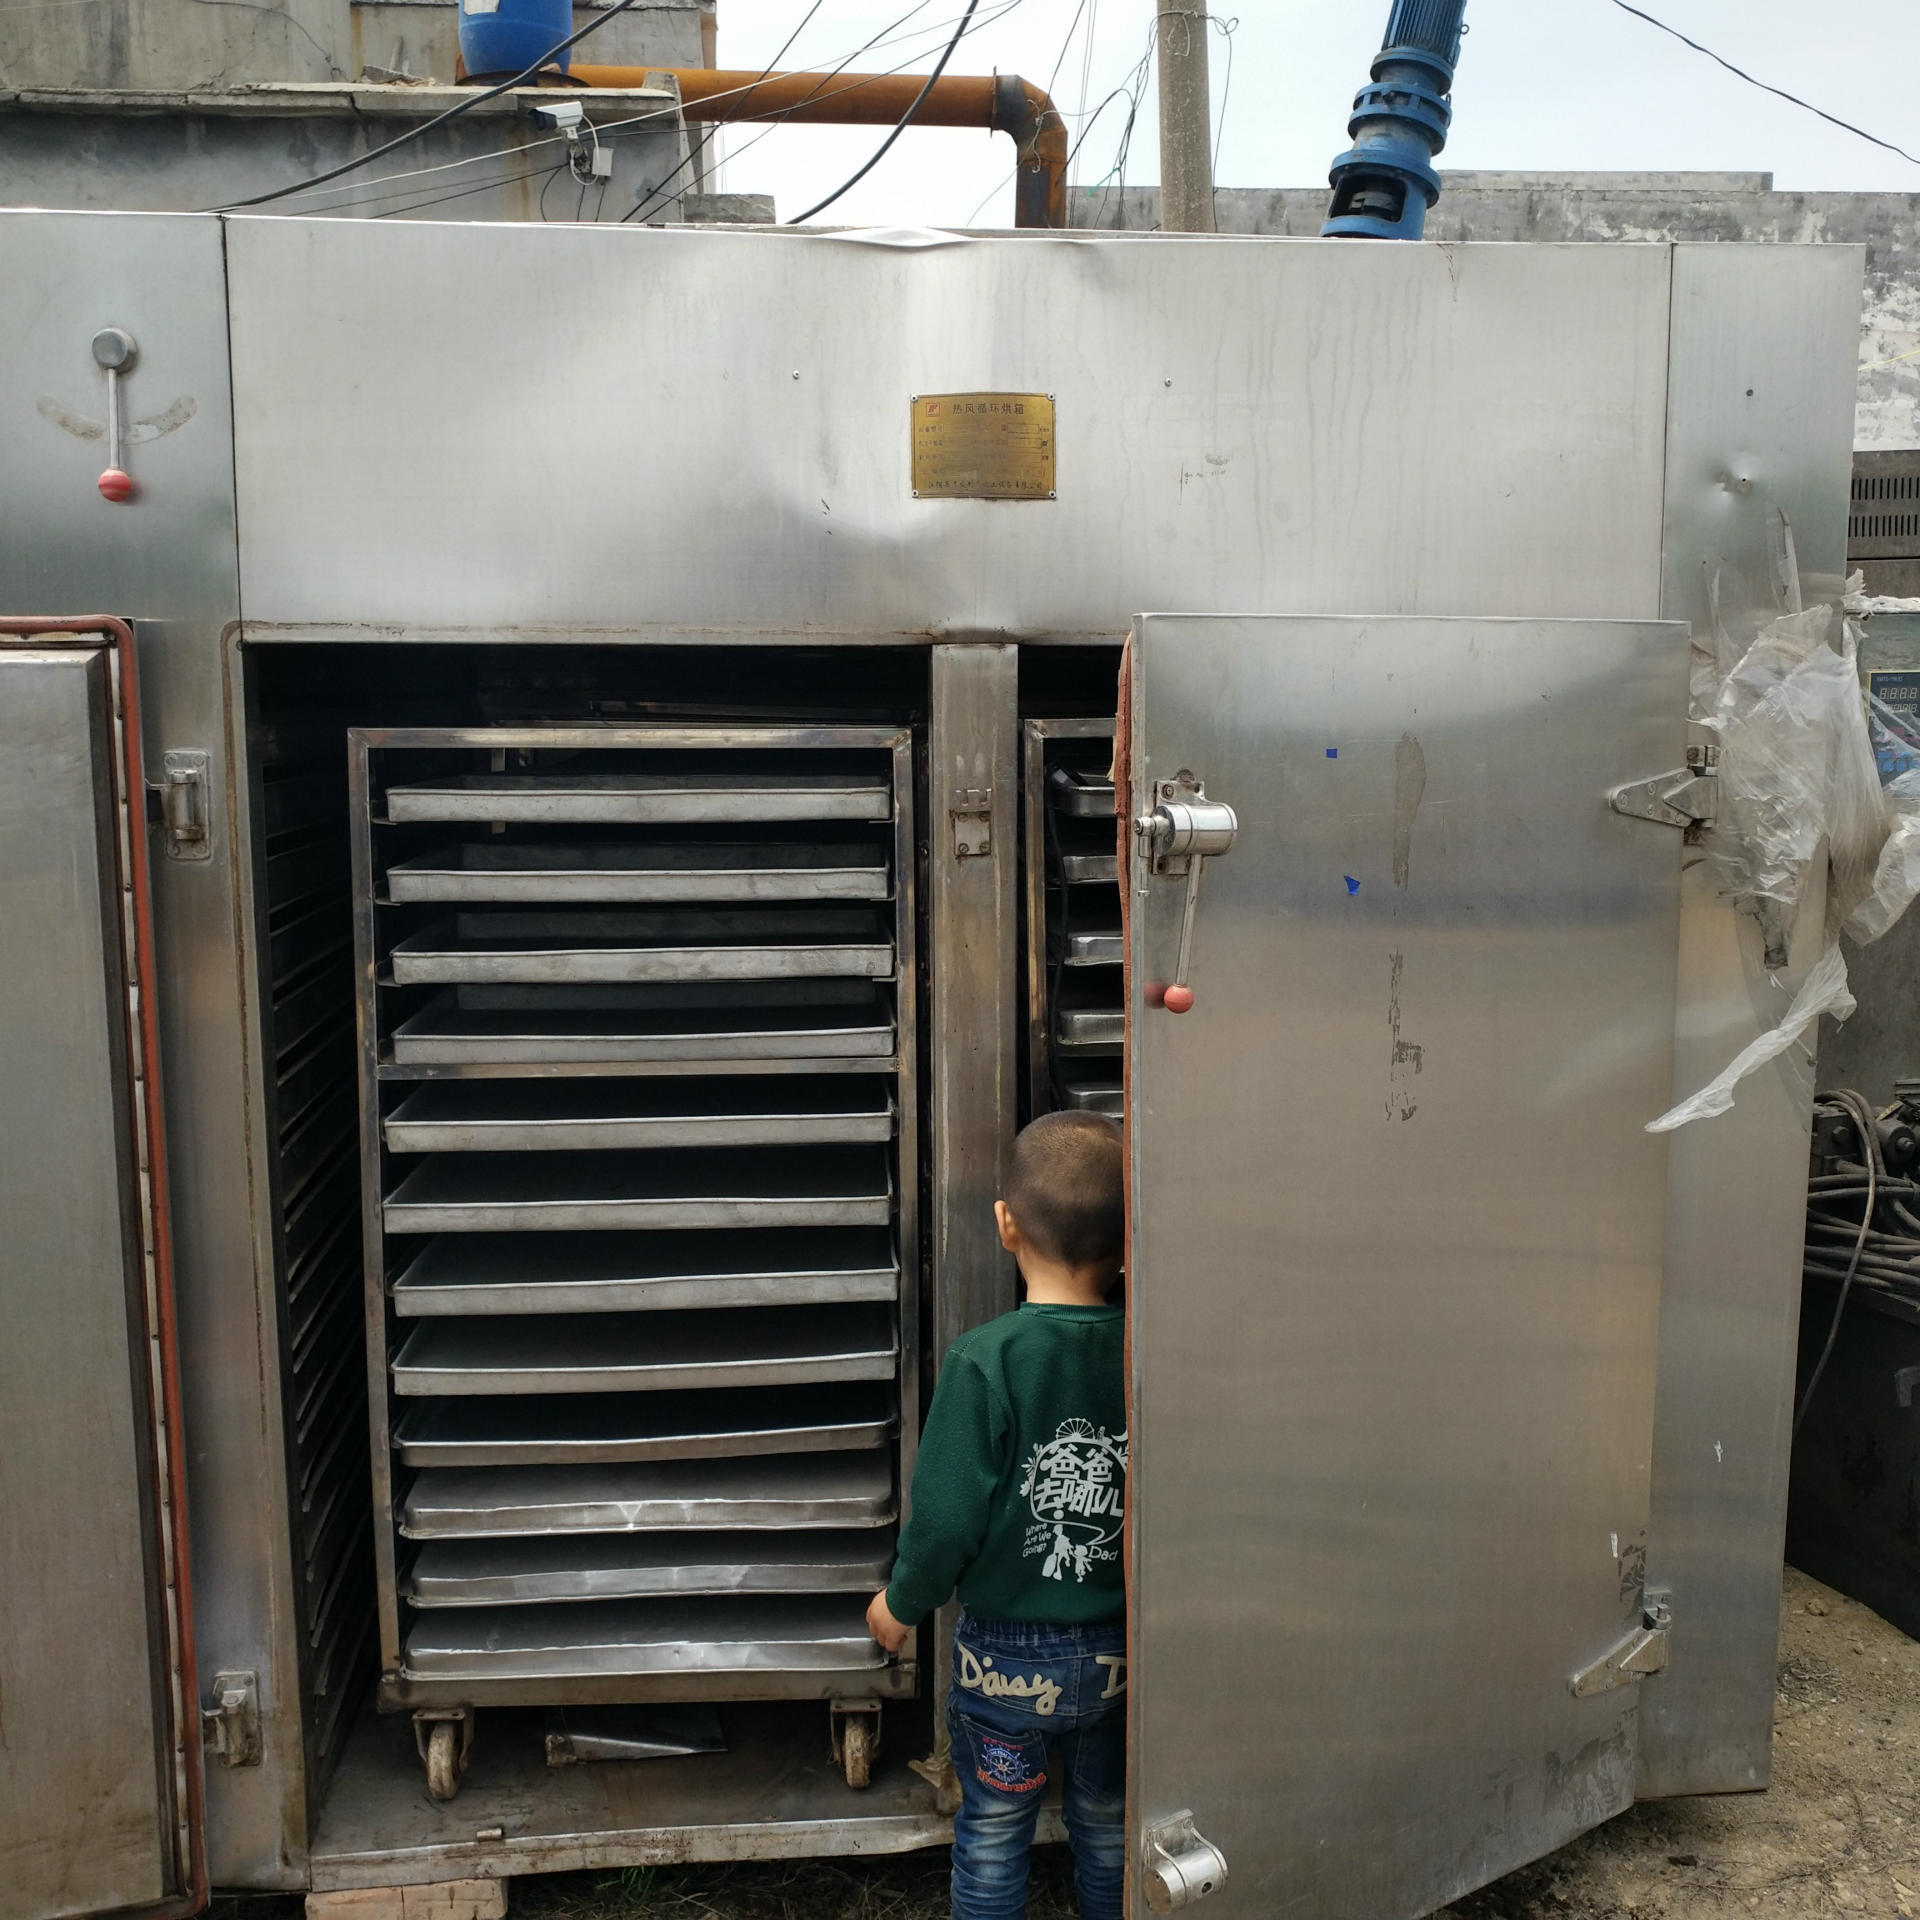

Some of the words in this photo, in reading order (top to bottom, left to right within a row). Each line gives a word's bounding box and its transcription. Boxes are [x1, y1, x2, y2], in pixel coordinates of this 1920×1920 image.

[952, 402, 1025, 416] 热风循环烘箱
[1040, 1443, 1114, 1483] 爸爸
[1033, 1477, 1124, 1518] 去哪儿
[1025, 1522, 1048, 1537] Where
[1023, 1535, 1038, 1546] Are
[1038, 1531, 1052, 1542] We
[1022, 1542, 1047, 1558] Going?
[1088, 1545, 1119, 1562] Dad
